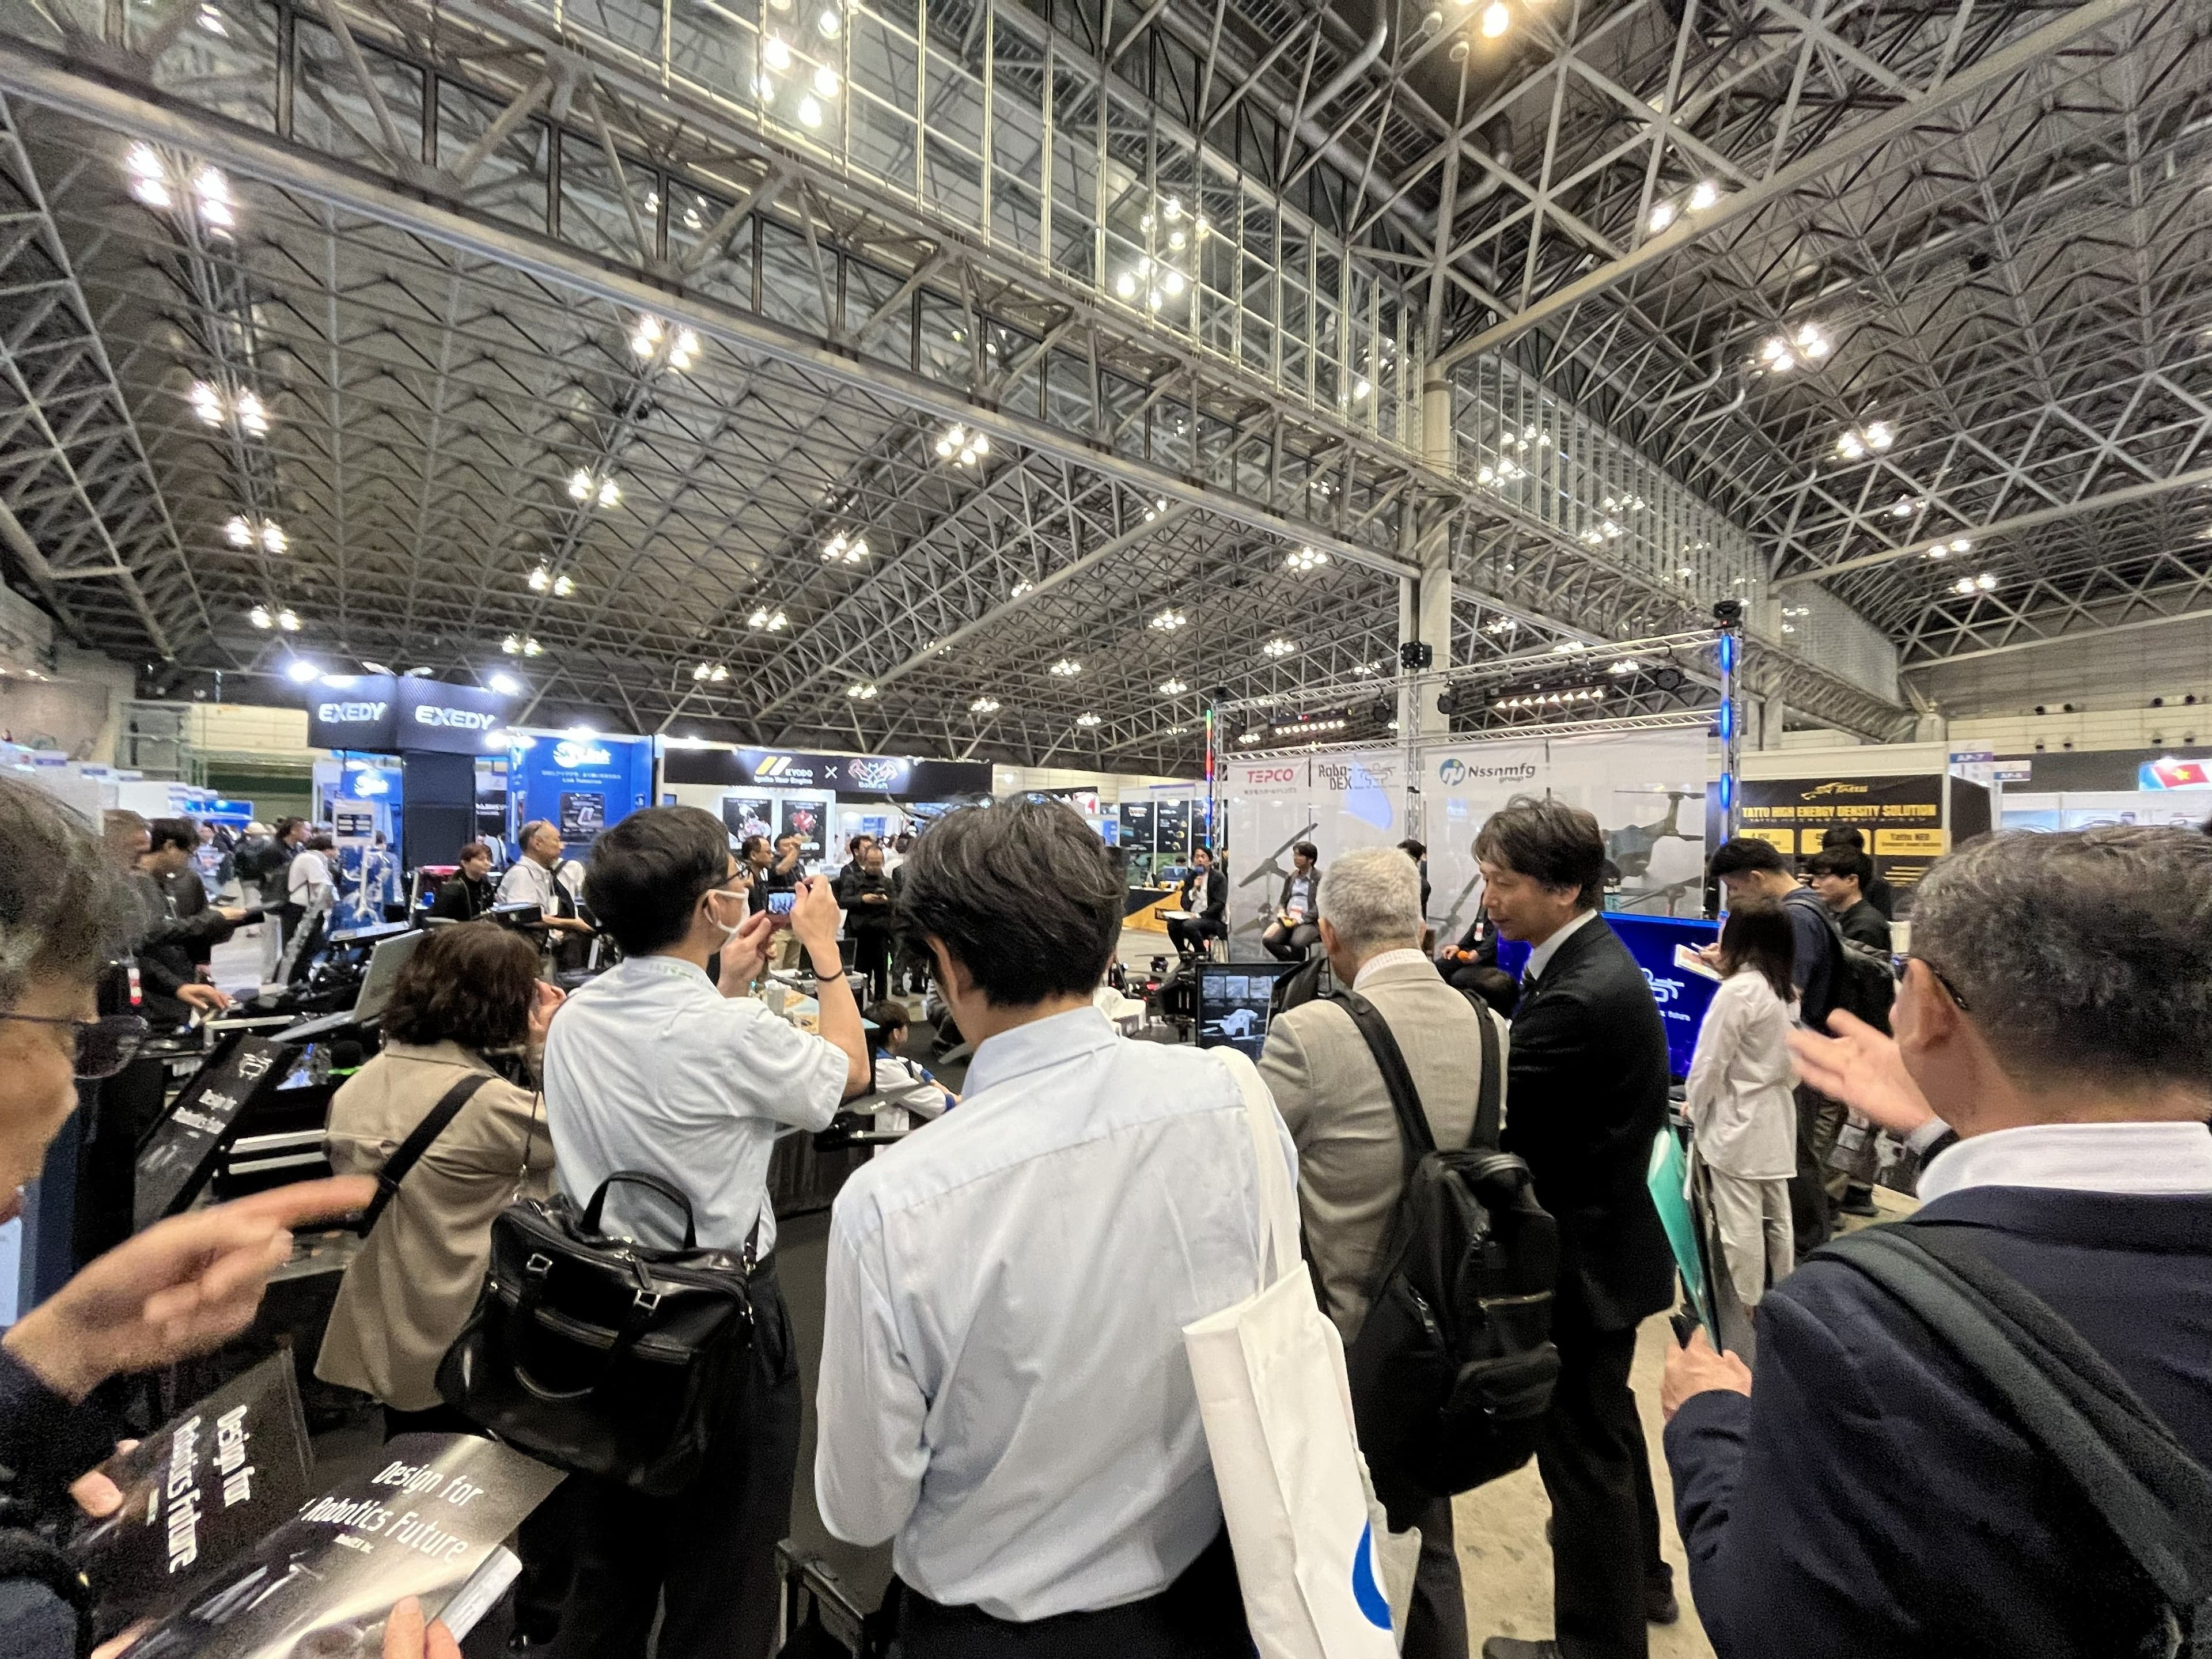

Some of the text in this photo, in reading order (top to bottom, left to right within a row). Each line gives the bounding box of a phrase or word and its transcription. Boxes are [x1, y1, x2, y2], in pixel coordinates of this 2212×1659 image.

[319, 702, 387, 723] EXEDY
[415, 705, 495, 730] EXEDY
[1247, 768, 1294, 784] TEPCO
[1468, 763, 1535, 778] Nssnmfg
[1330, 777, 1352, 791] DEX
[1499, 776, 1524, 784] group
[1836, 805, 1880, 817] DENSITY
[1881, 805, 1937, 816] SOLUTION
[371, 1460, 484, 1506] Design for
[301, 1497, 394, 1532] Robotics
[384, 1510, 469, 1563] Future
